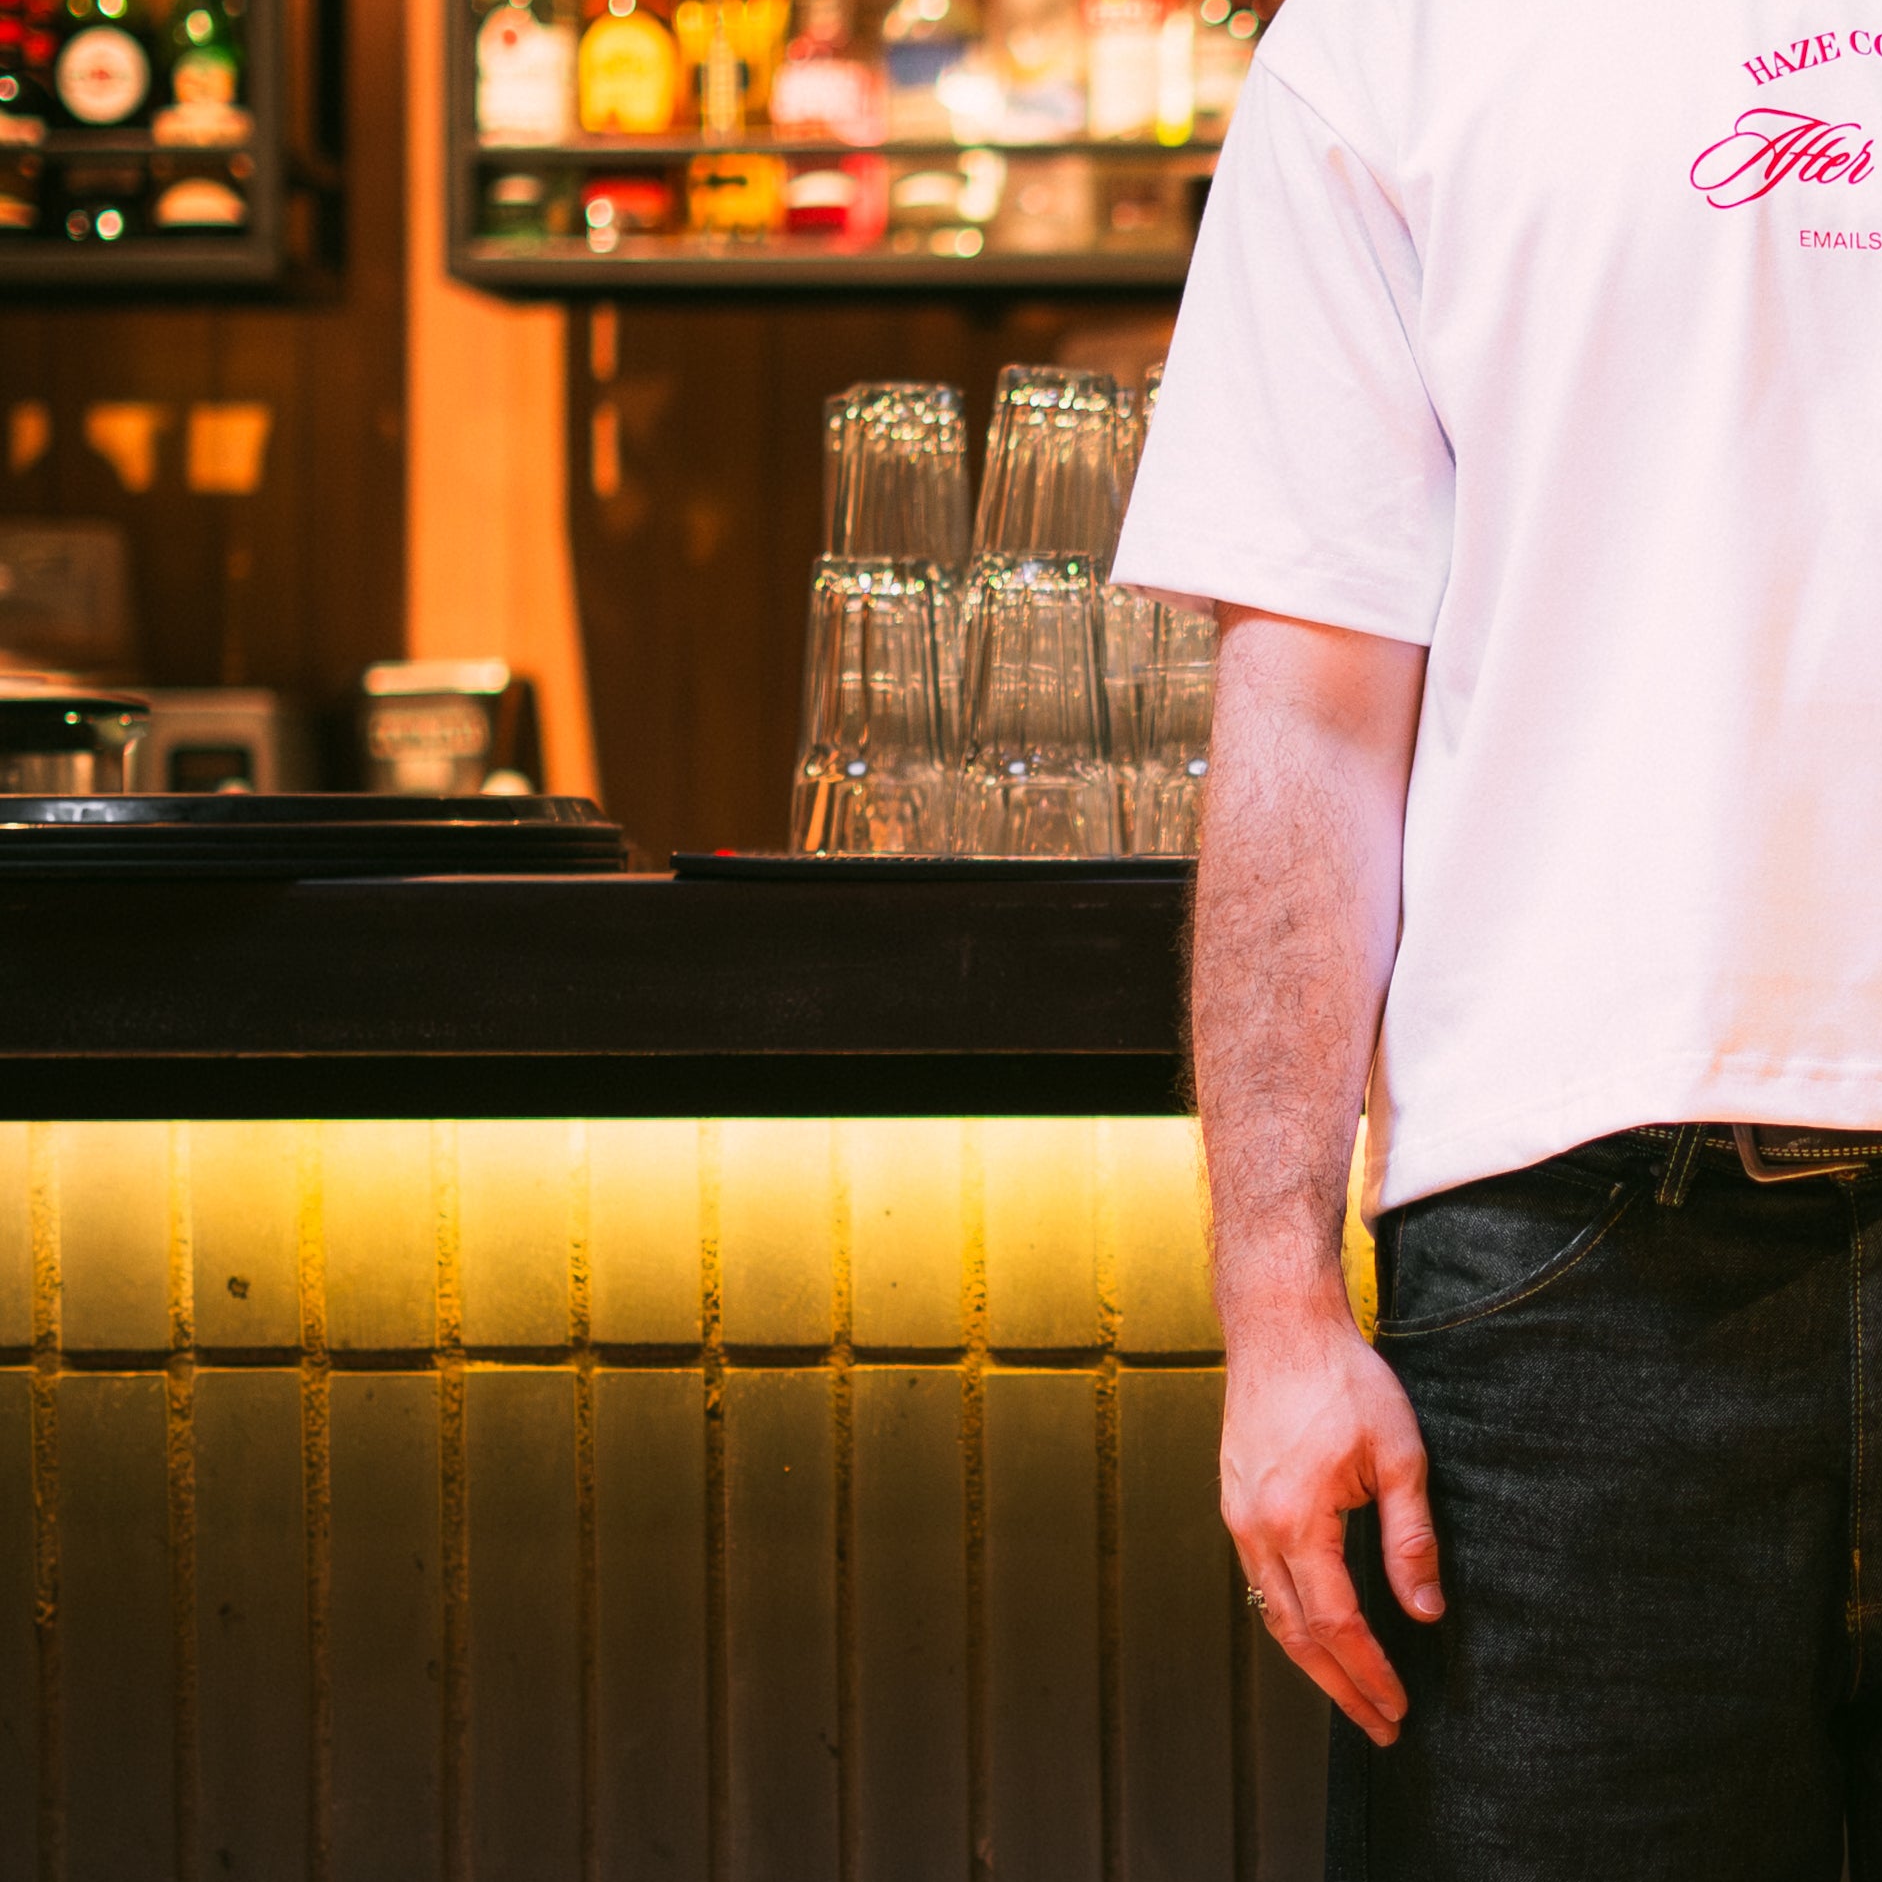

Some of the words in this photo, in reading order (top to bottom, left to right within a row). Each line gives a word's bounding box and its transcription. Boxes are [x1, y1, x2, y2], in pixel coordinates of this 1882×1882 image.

[1742, 31, 1841, 87] HAZE
[1689, 107, 1876, 210] After
[1799, 229, 1882, 251] EMAILS
